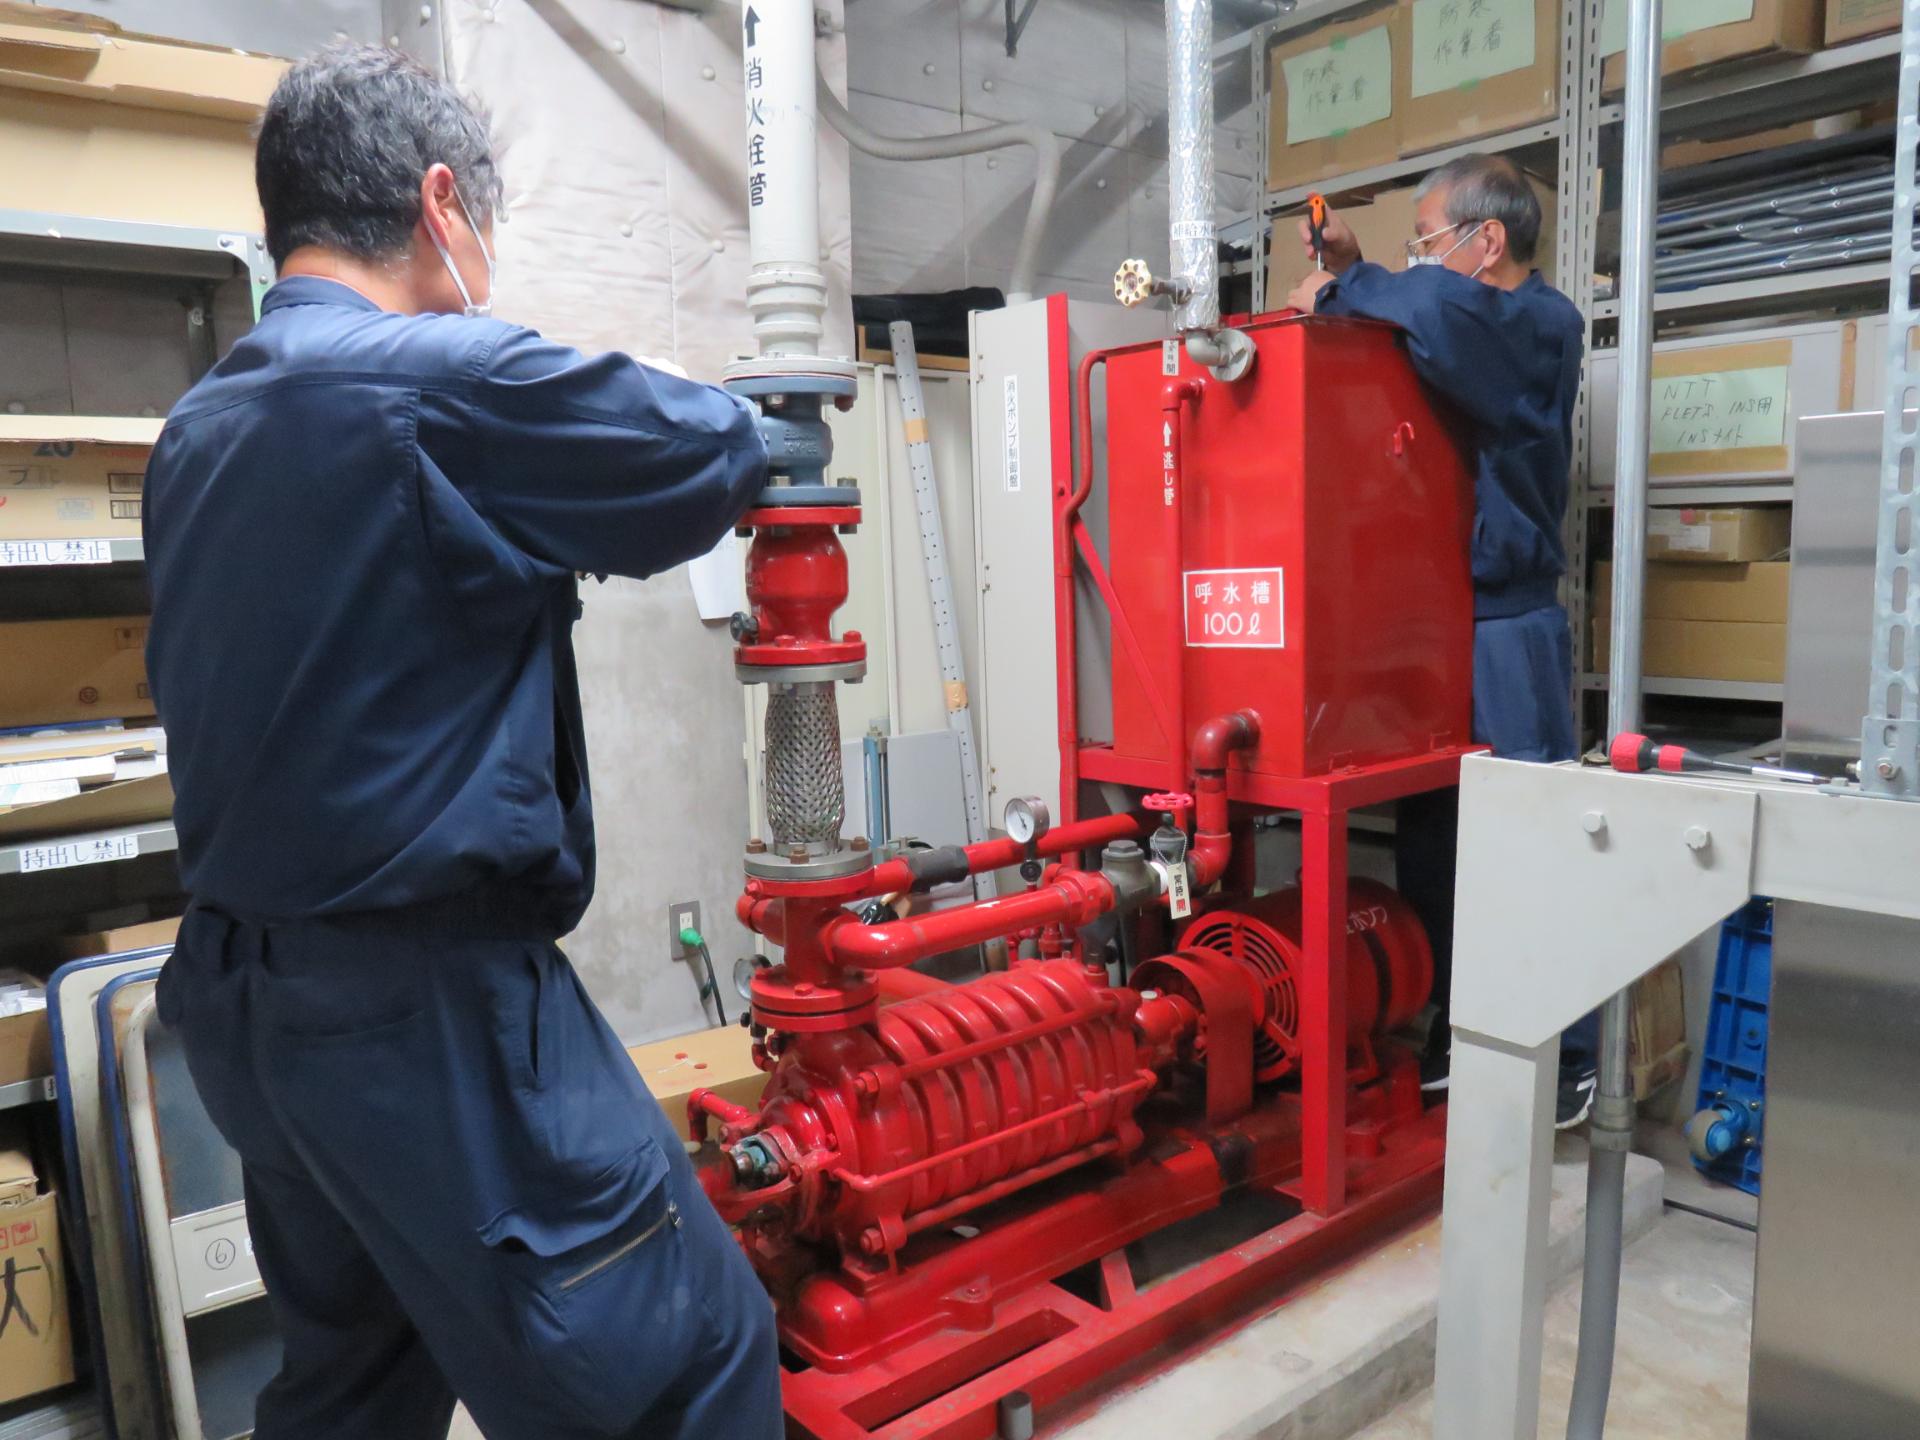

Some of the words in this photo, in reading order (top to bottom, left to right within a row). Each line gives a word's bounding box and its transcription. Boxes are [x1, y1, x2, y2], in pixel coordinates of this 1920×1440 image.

[745, 56, 767, 208] 消火栓管
[1194, 580, 1271, 605] 呼水槽
[24, 837, 134, 870] 持出し禁止
